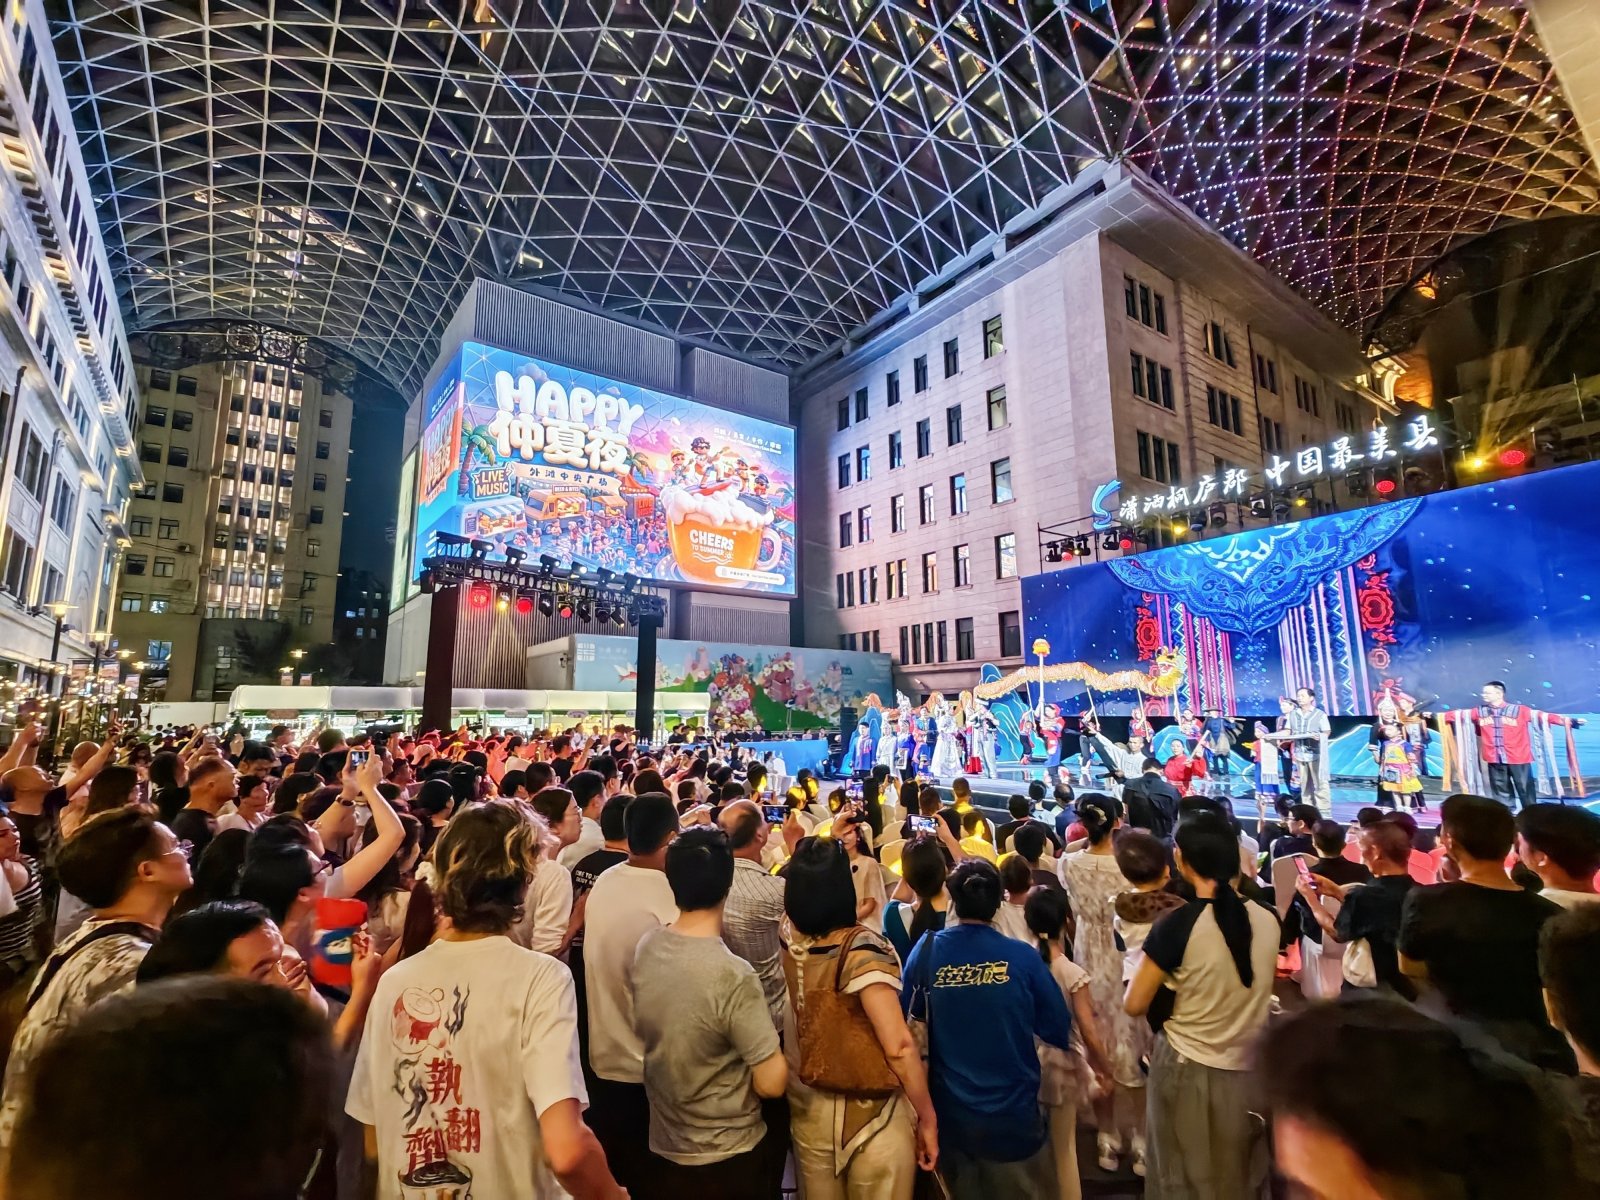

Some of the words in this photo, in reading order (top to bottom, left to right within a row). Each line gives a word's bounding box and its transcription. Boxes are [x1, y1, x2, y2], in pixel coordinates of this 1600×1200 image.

[495, 370, 645, 436] HAPPY
[488, 410, 631, 475] 仲夏夜
[481, 470, 504, 484] LIVE
[529, 467, 608, 487] 外滩中央广场
[1119, 468, 1248, 521] 潇洒桐庐郡
[1265, 415, 1439, 486] 中国最美县
[476, 481, 509, 497] MUSIC
[689, 528, 735, 551] CHEERS
[700, 546, 724, 556] SUMMER
